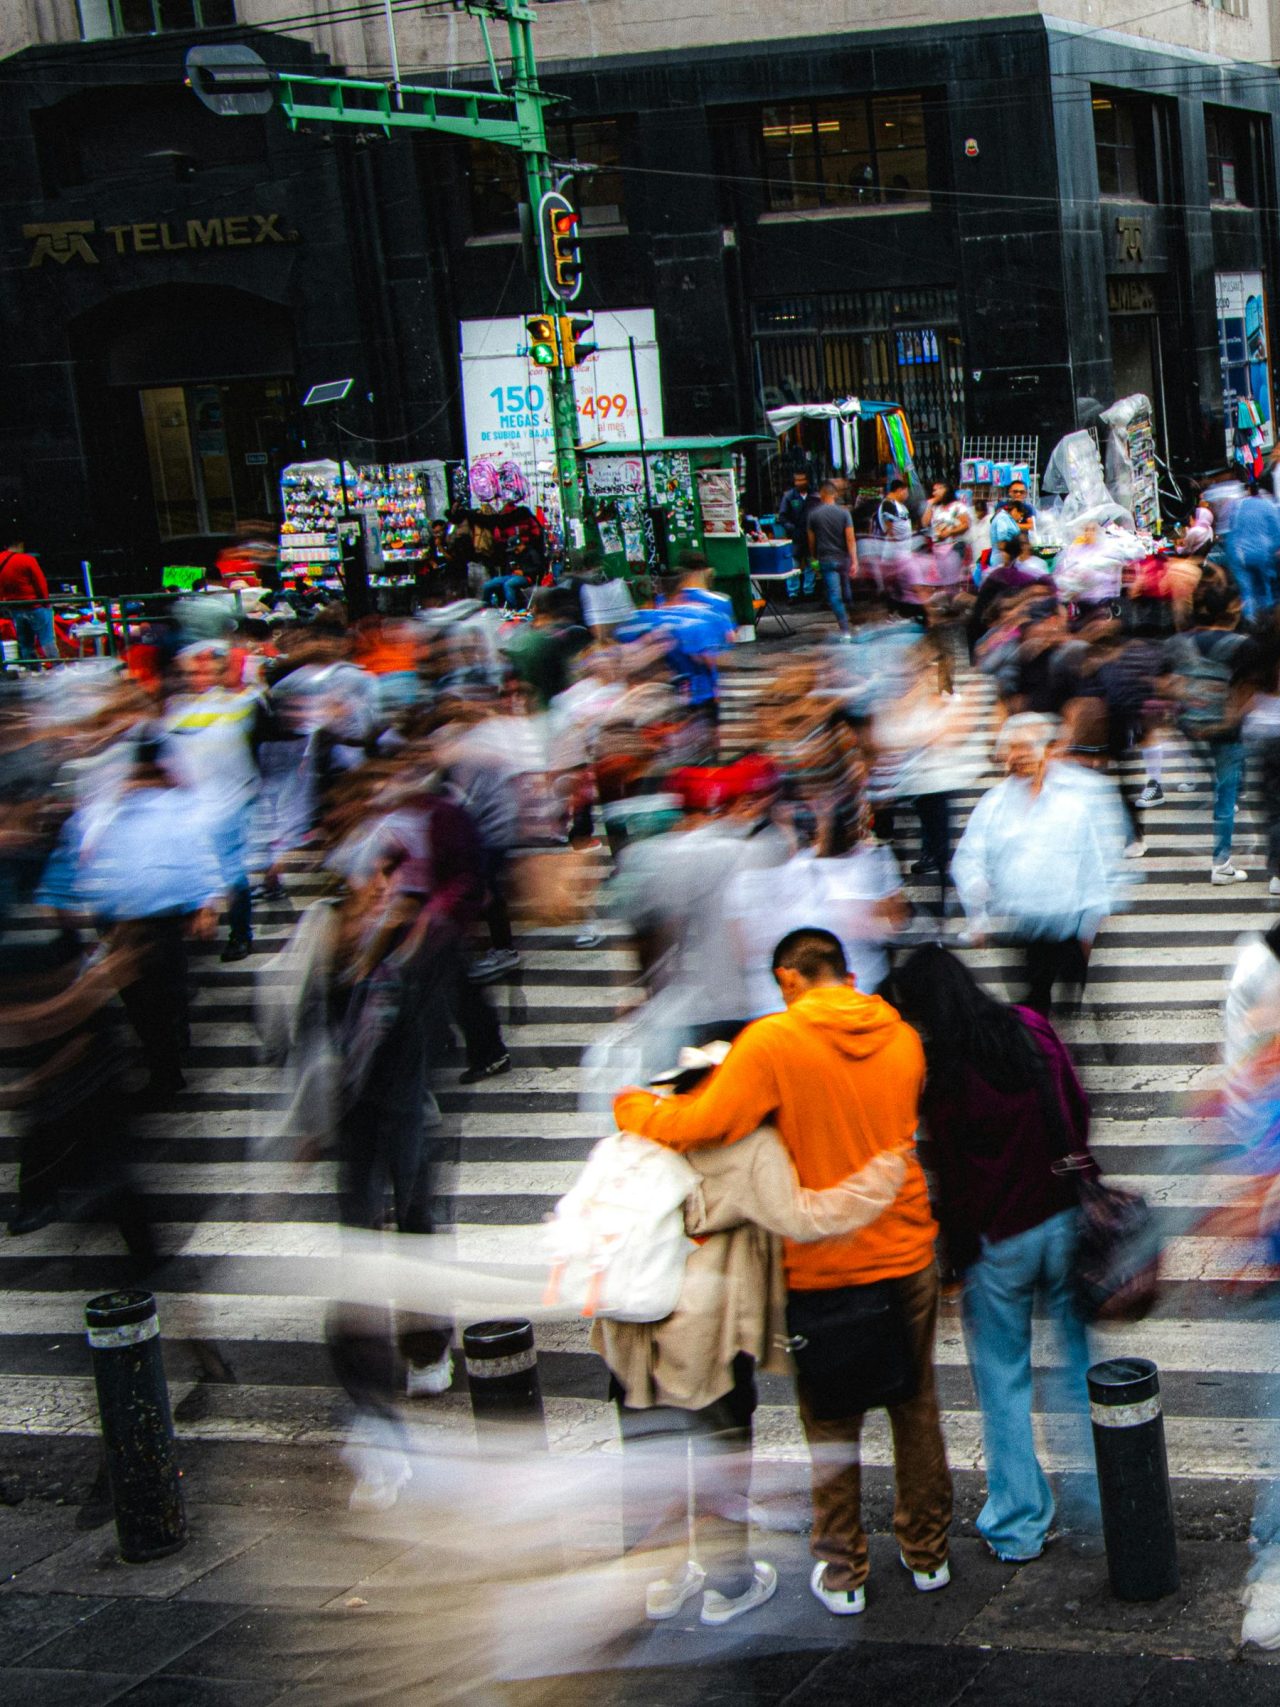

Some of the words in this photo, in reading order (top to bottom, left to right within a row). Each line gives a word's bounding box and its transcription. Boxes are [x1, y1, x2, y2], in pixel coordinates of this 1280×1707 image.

[105, 213, 285, 254] TELMEX
[490, 384, 544, 413] 150
[500, 414, 540, 428] MEGAS
[608, 422, 626, 432] mes
[481, 431, 491, 441] DE
[493, 429, 521, 440] SUBIDA
